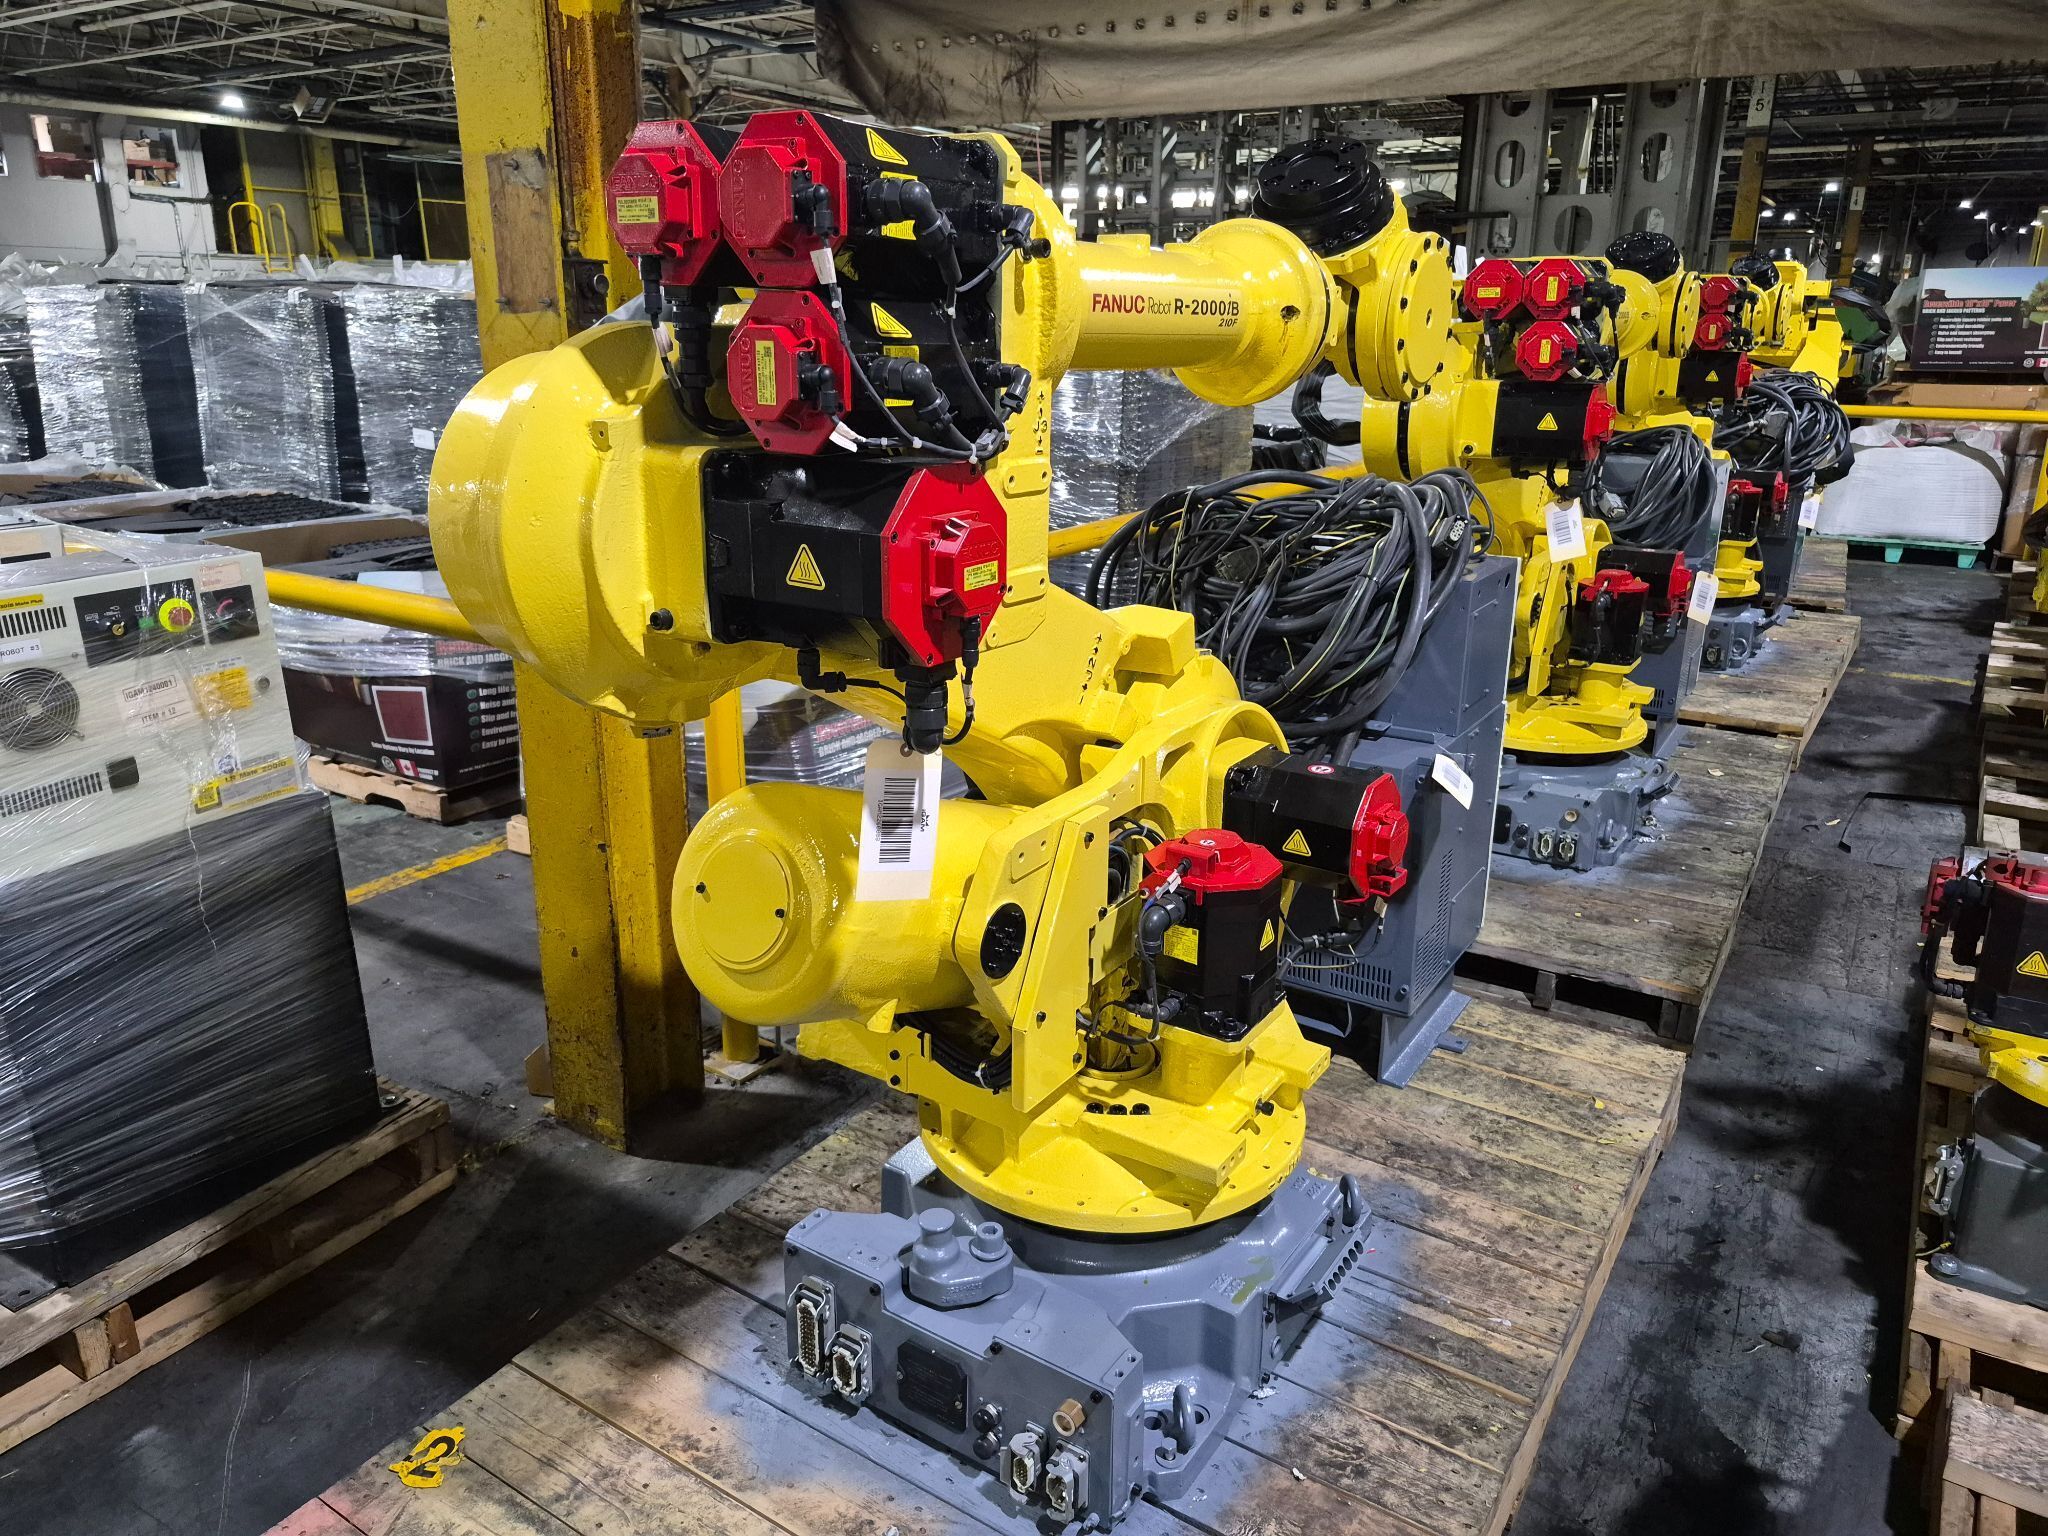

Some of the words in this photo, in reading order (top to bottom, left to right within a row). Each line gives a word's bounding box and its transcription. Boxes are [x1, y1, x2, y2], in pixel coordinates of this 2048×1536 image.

[1755, 98, 1765, 111] 5
[1092, 294, 1145, 314] FANUC
[1147, 297, 1171, 315] Robot
[1174, 293, 1240, 316] R-2000iB
[1218, 318, 1238, 328] 210F
[740, 337, 753, 406] FANUC
[1033, 420, 1048, 433] J3
[0, 647, 25, 658] ROBOT
[437, 656, 465, 668] BRICK
[466, 654, 483, 666] AND
[479, 686, 497, 697] Long
[481, 700, 501, 710] Noise
[142, 712, 160, 724] ITEM
[168, 706, 176, 716] 12
[481, 714, 496, 723] Slip
[497, 712, 509, 720] and
[482, 740, 498, 750] Easy
[240, 769, 258, 779] Mate
[408, 1436, 456, 1478] 2
